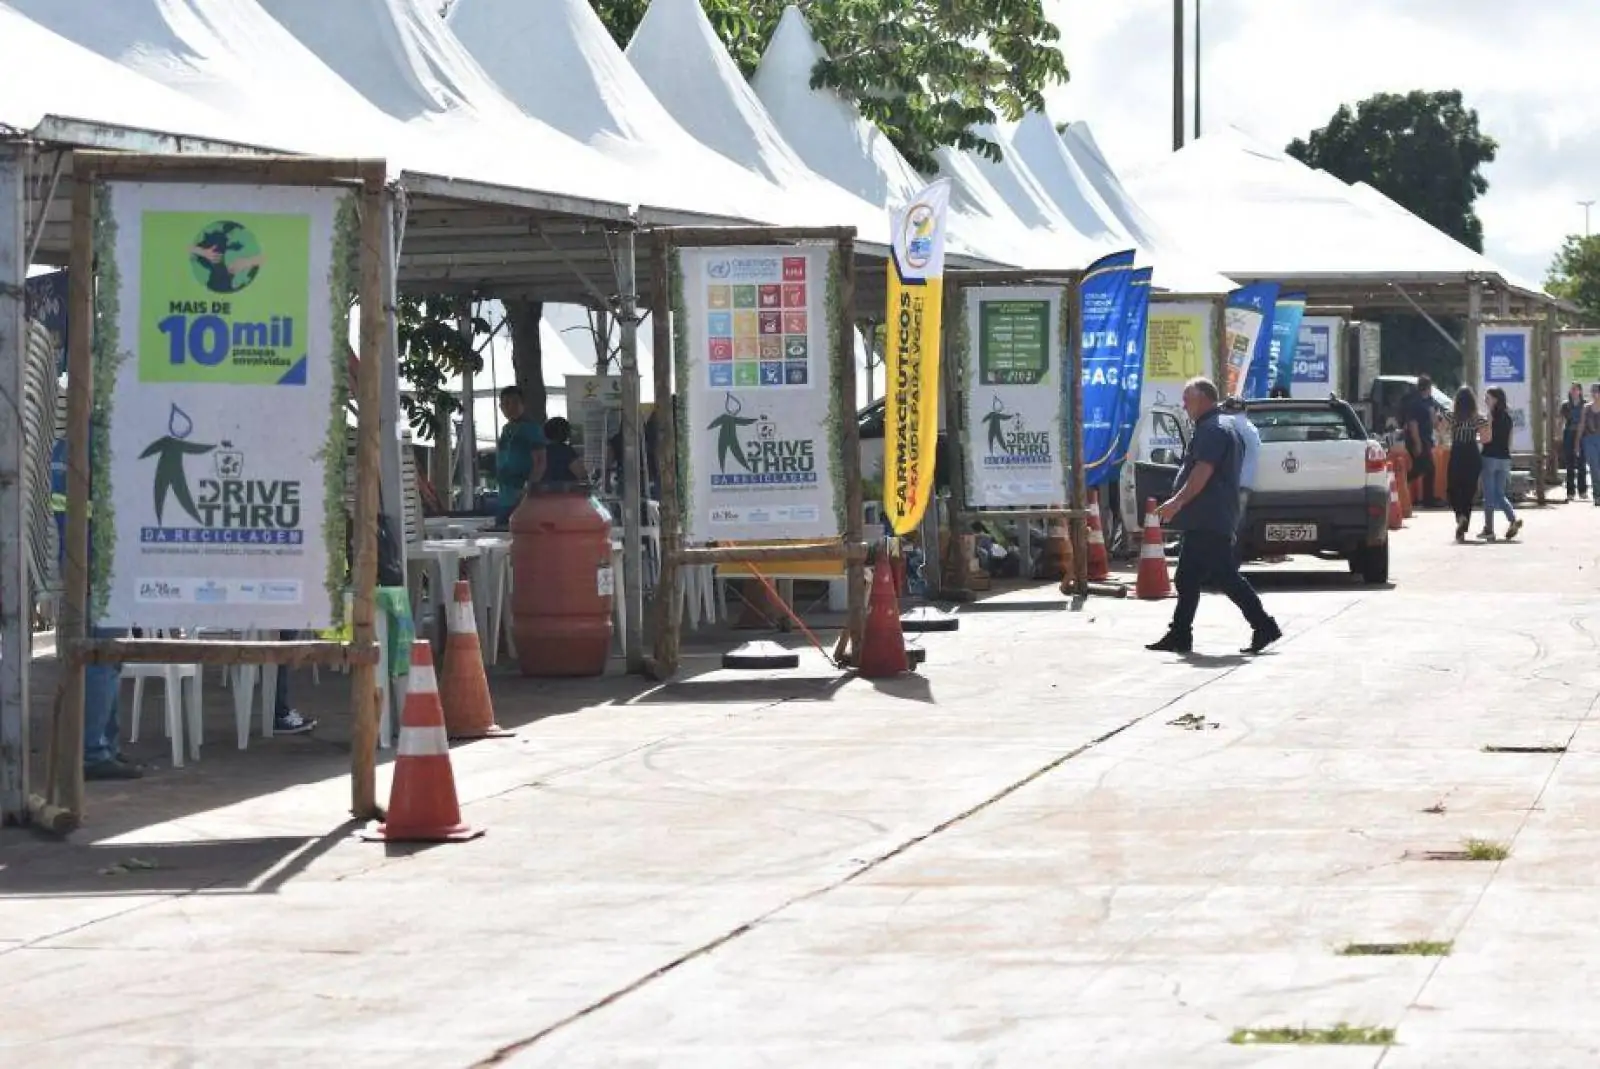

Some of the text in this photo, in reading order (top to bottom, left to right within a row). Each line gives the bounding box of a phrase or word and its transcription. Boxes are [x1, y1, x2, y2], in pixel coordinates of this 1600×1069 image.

[169, 301, 231, 315] MAIS DE
[158, 315, 293, 366] 10 mil
[1007, 432, 1050, 444] DRIVE
[748, 440, 813, 457] DRIVE
[1007, 443, 1050, 457] THRU
[747, 456, 814, 473] THRU
[199, 480, 301, 505] DRIVE
[198, 504, 300, 528] THRU
[145, 529, 300, 543] DA RECICLAGEM
